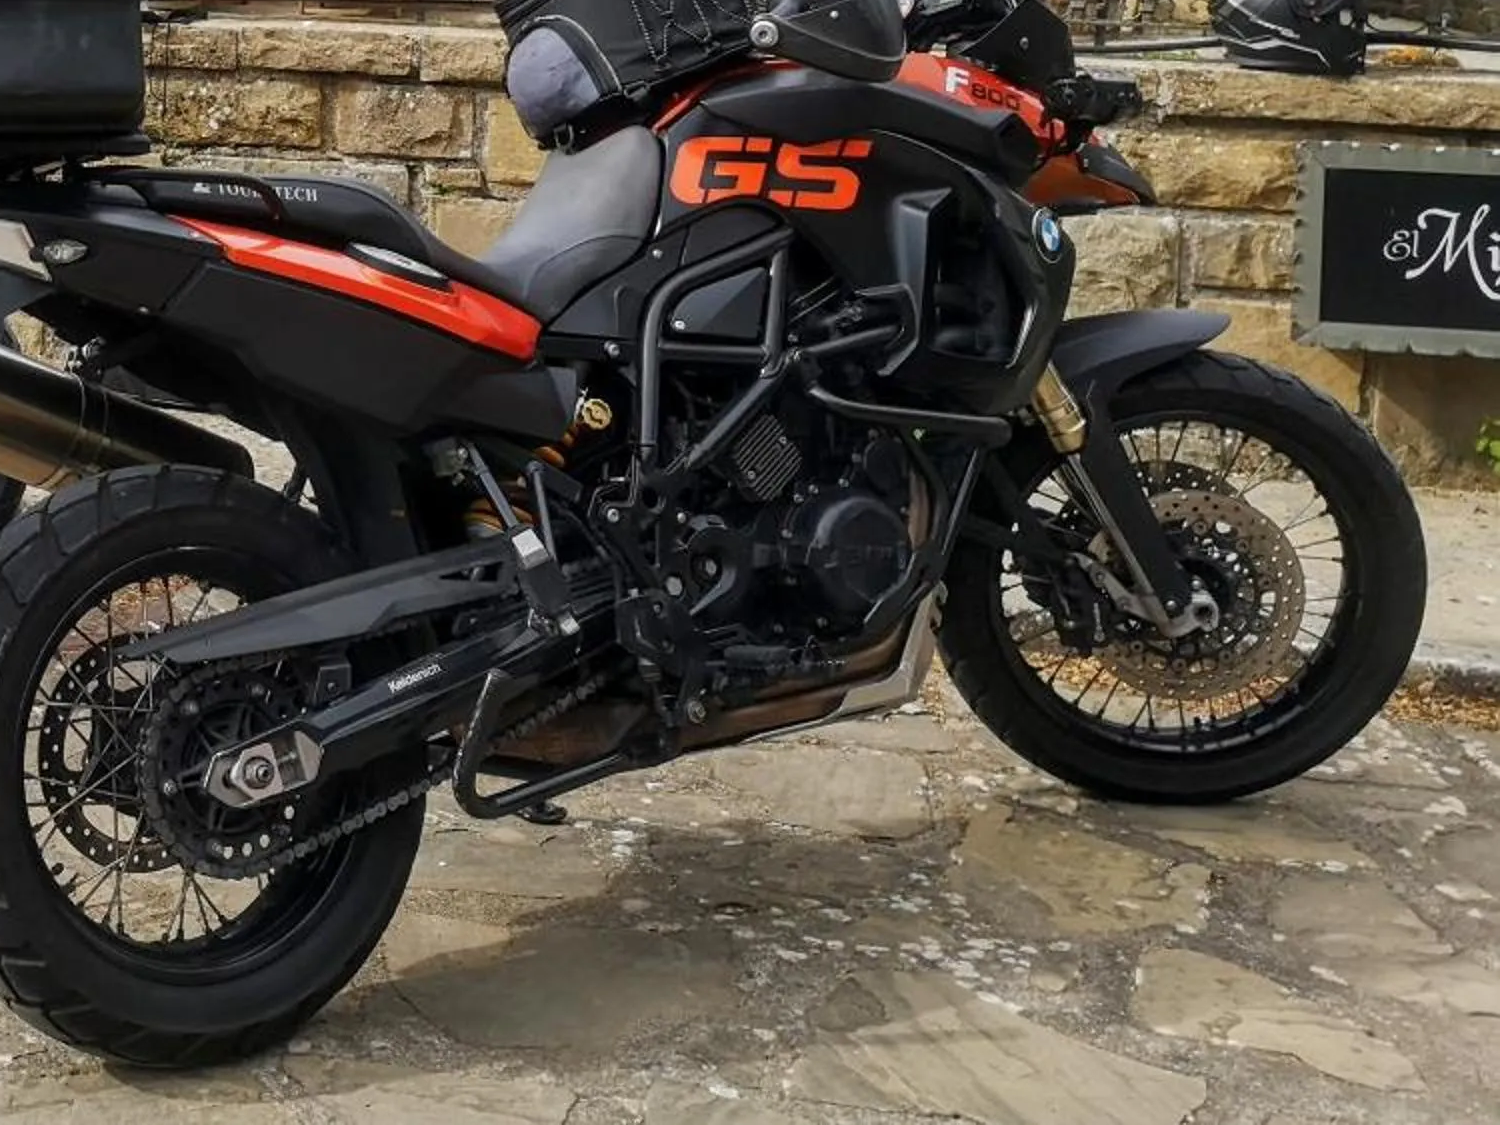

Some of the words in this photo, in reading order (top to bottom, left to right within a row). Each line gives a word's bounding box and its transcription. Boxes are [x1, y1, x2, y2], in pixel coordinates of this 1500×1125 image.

[945, 66, 970, 93] F
[971, 82, 1022, 112] 800
[669, 136, 874, 211] GS
[1383, 229, 1419, 261] El
